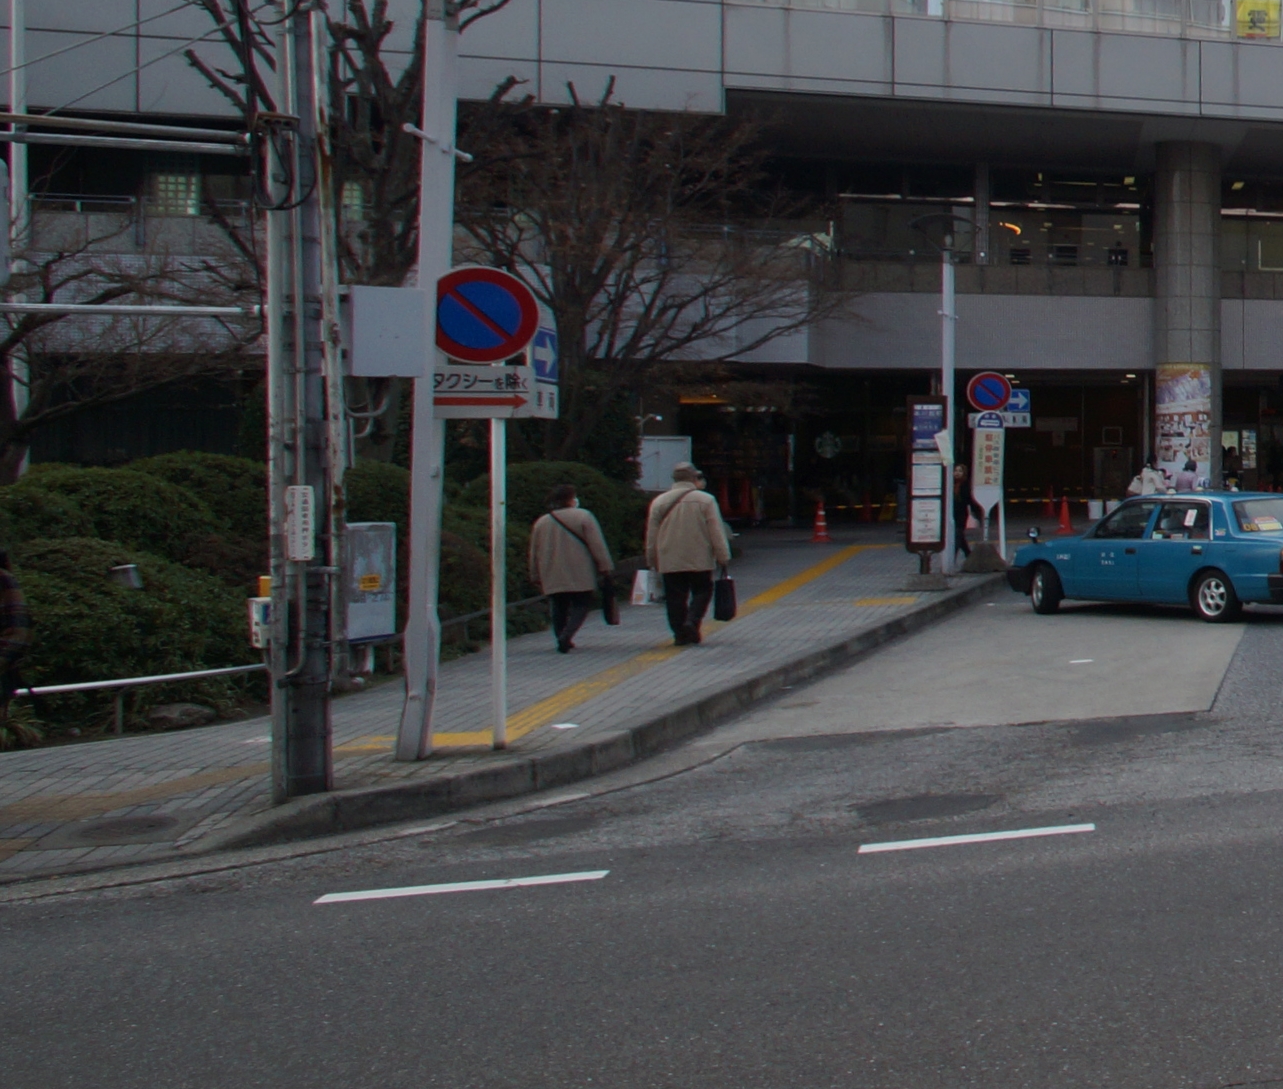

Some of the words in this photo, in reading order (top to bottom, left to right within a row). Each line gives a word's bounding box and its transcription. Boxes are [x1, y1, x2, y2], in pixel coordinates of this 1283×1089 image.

[433, 373, 528, 390] タクシーを除く
